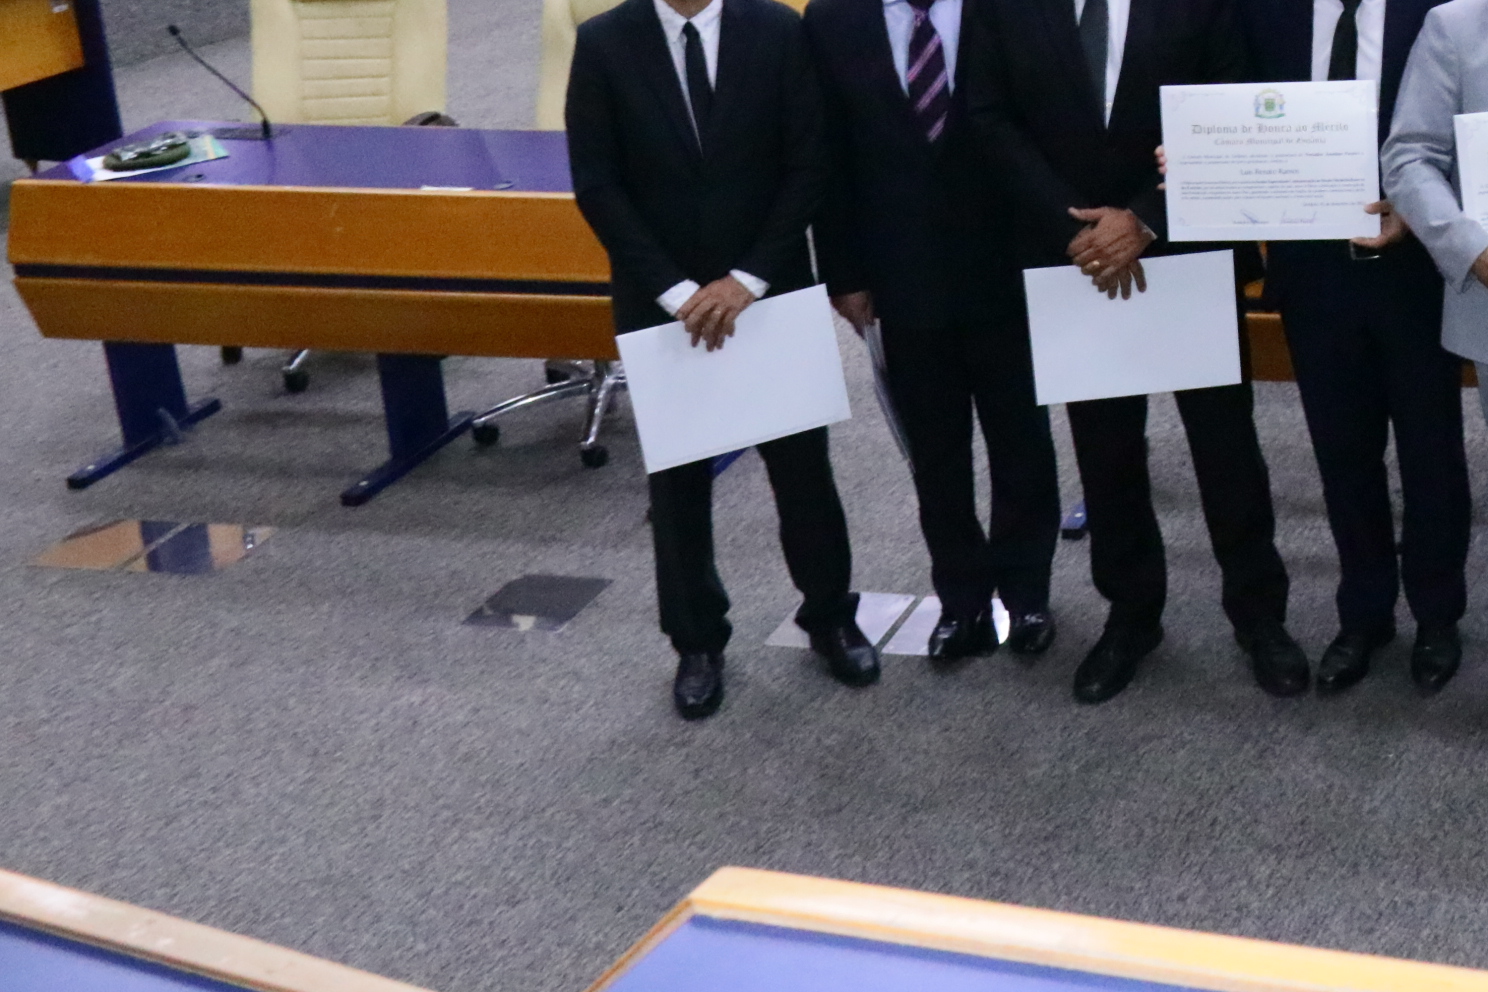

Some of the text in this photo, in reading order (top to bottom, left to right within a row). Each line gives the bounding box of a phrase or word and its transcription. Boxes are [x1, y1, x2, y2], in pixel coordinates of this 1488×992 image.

[1191, 124, 1238, 135] Diploma
[1242, 124, 1252, 133] de
[1257, 123, 1292, 133] Honra
